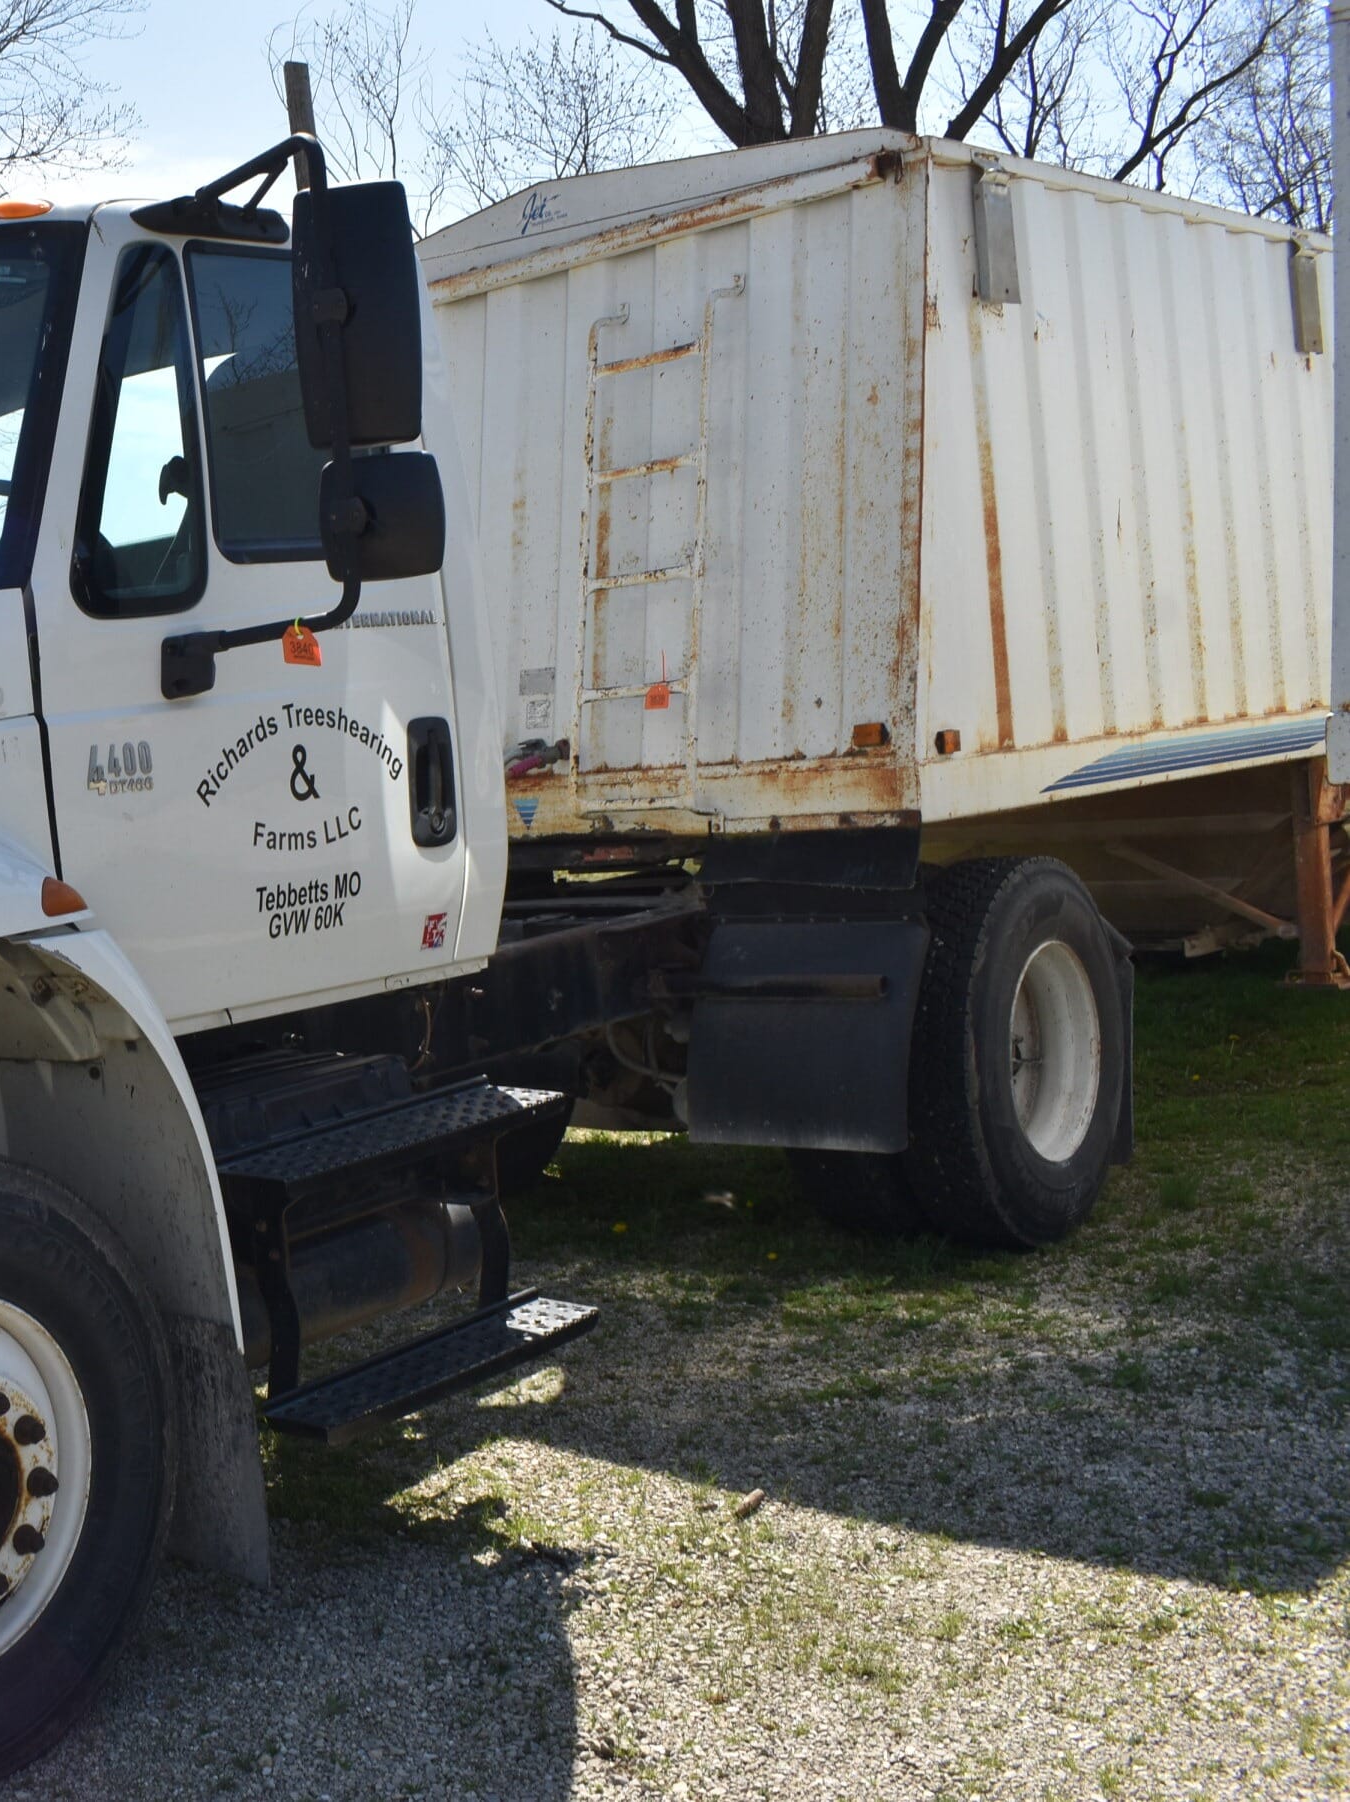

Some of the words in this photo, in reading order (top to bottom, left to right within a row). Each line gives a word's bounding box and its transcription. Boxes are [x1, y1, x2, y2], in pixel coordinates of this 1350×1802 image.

[334, 609, 437, 629] TERNATIONAL
[87, 741, 153, 796] 4400
[196, 715, 279, 808] Richards
[281, 703, 403, 781] Treeshearing
[290, 744, 321, 801] &
[253, 821, 318, 851] Farms
[323, 806, 362, 844] LLC
[256, 879, 329, 913] Tebbetts
[334, 871, 361, 900] MO
[268, 907, 311, 939] GVW
[314, 902, 345, 931] 60K
